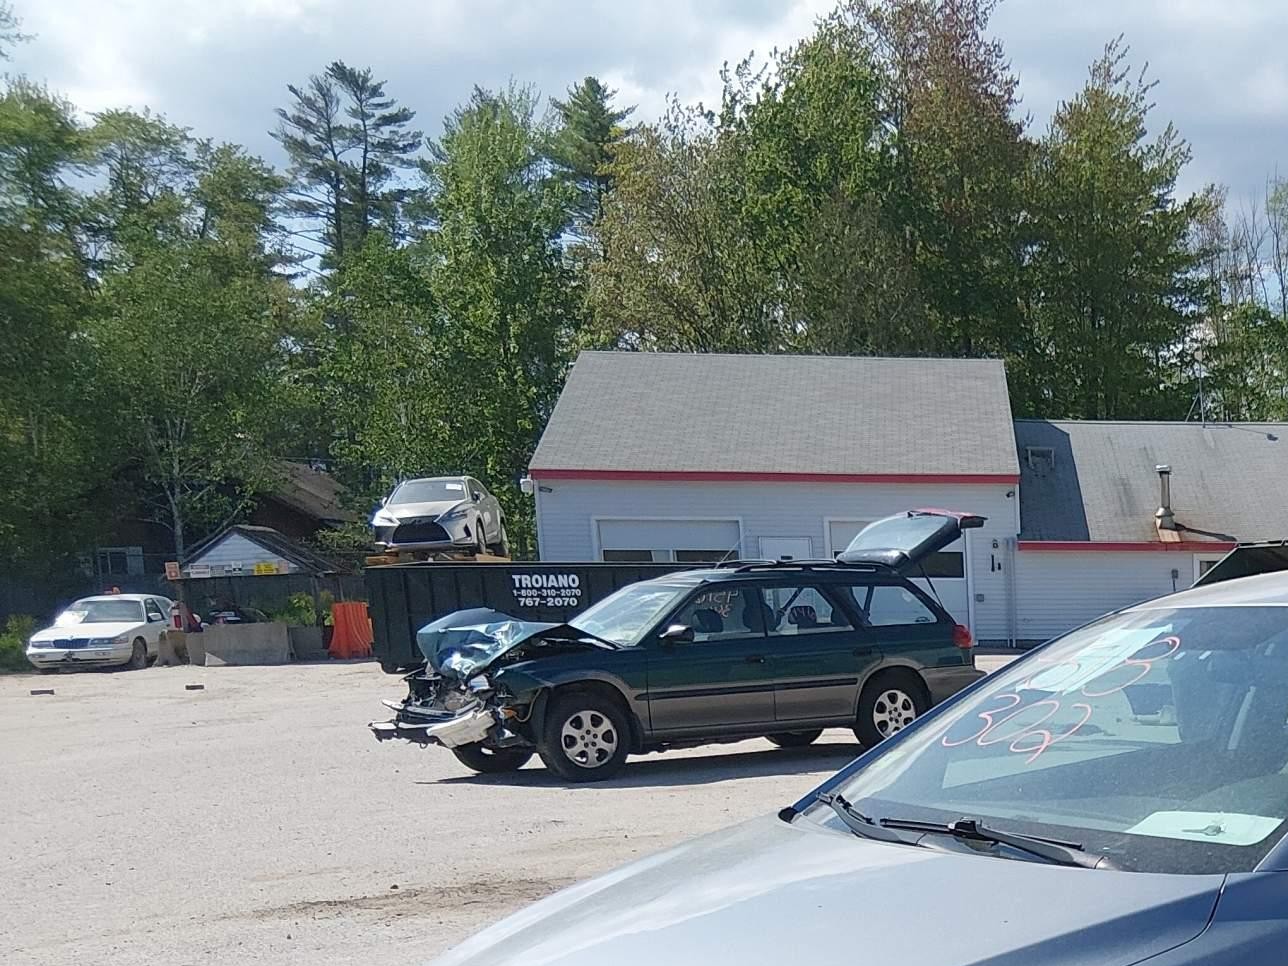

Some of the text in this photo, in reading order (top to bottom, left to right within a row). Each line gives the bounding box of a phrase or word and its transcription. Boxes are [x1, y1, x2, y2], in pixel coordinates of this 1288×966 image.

[511, 574, 580, 588] TROIANO
[512, 588, 582, 597] 1-800-310-2070
[518, 597, 578, 607] 767-2070
